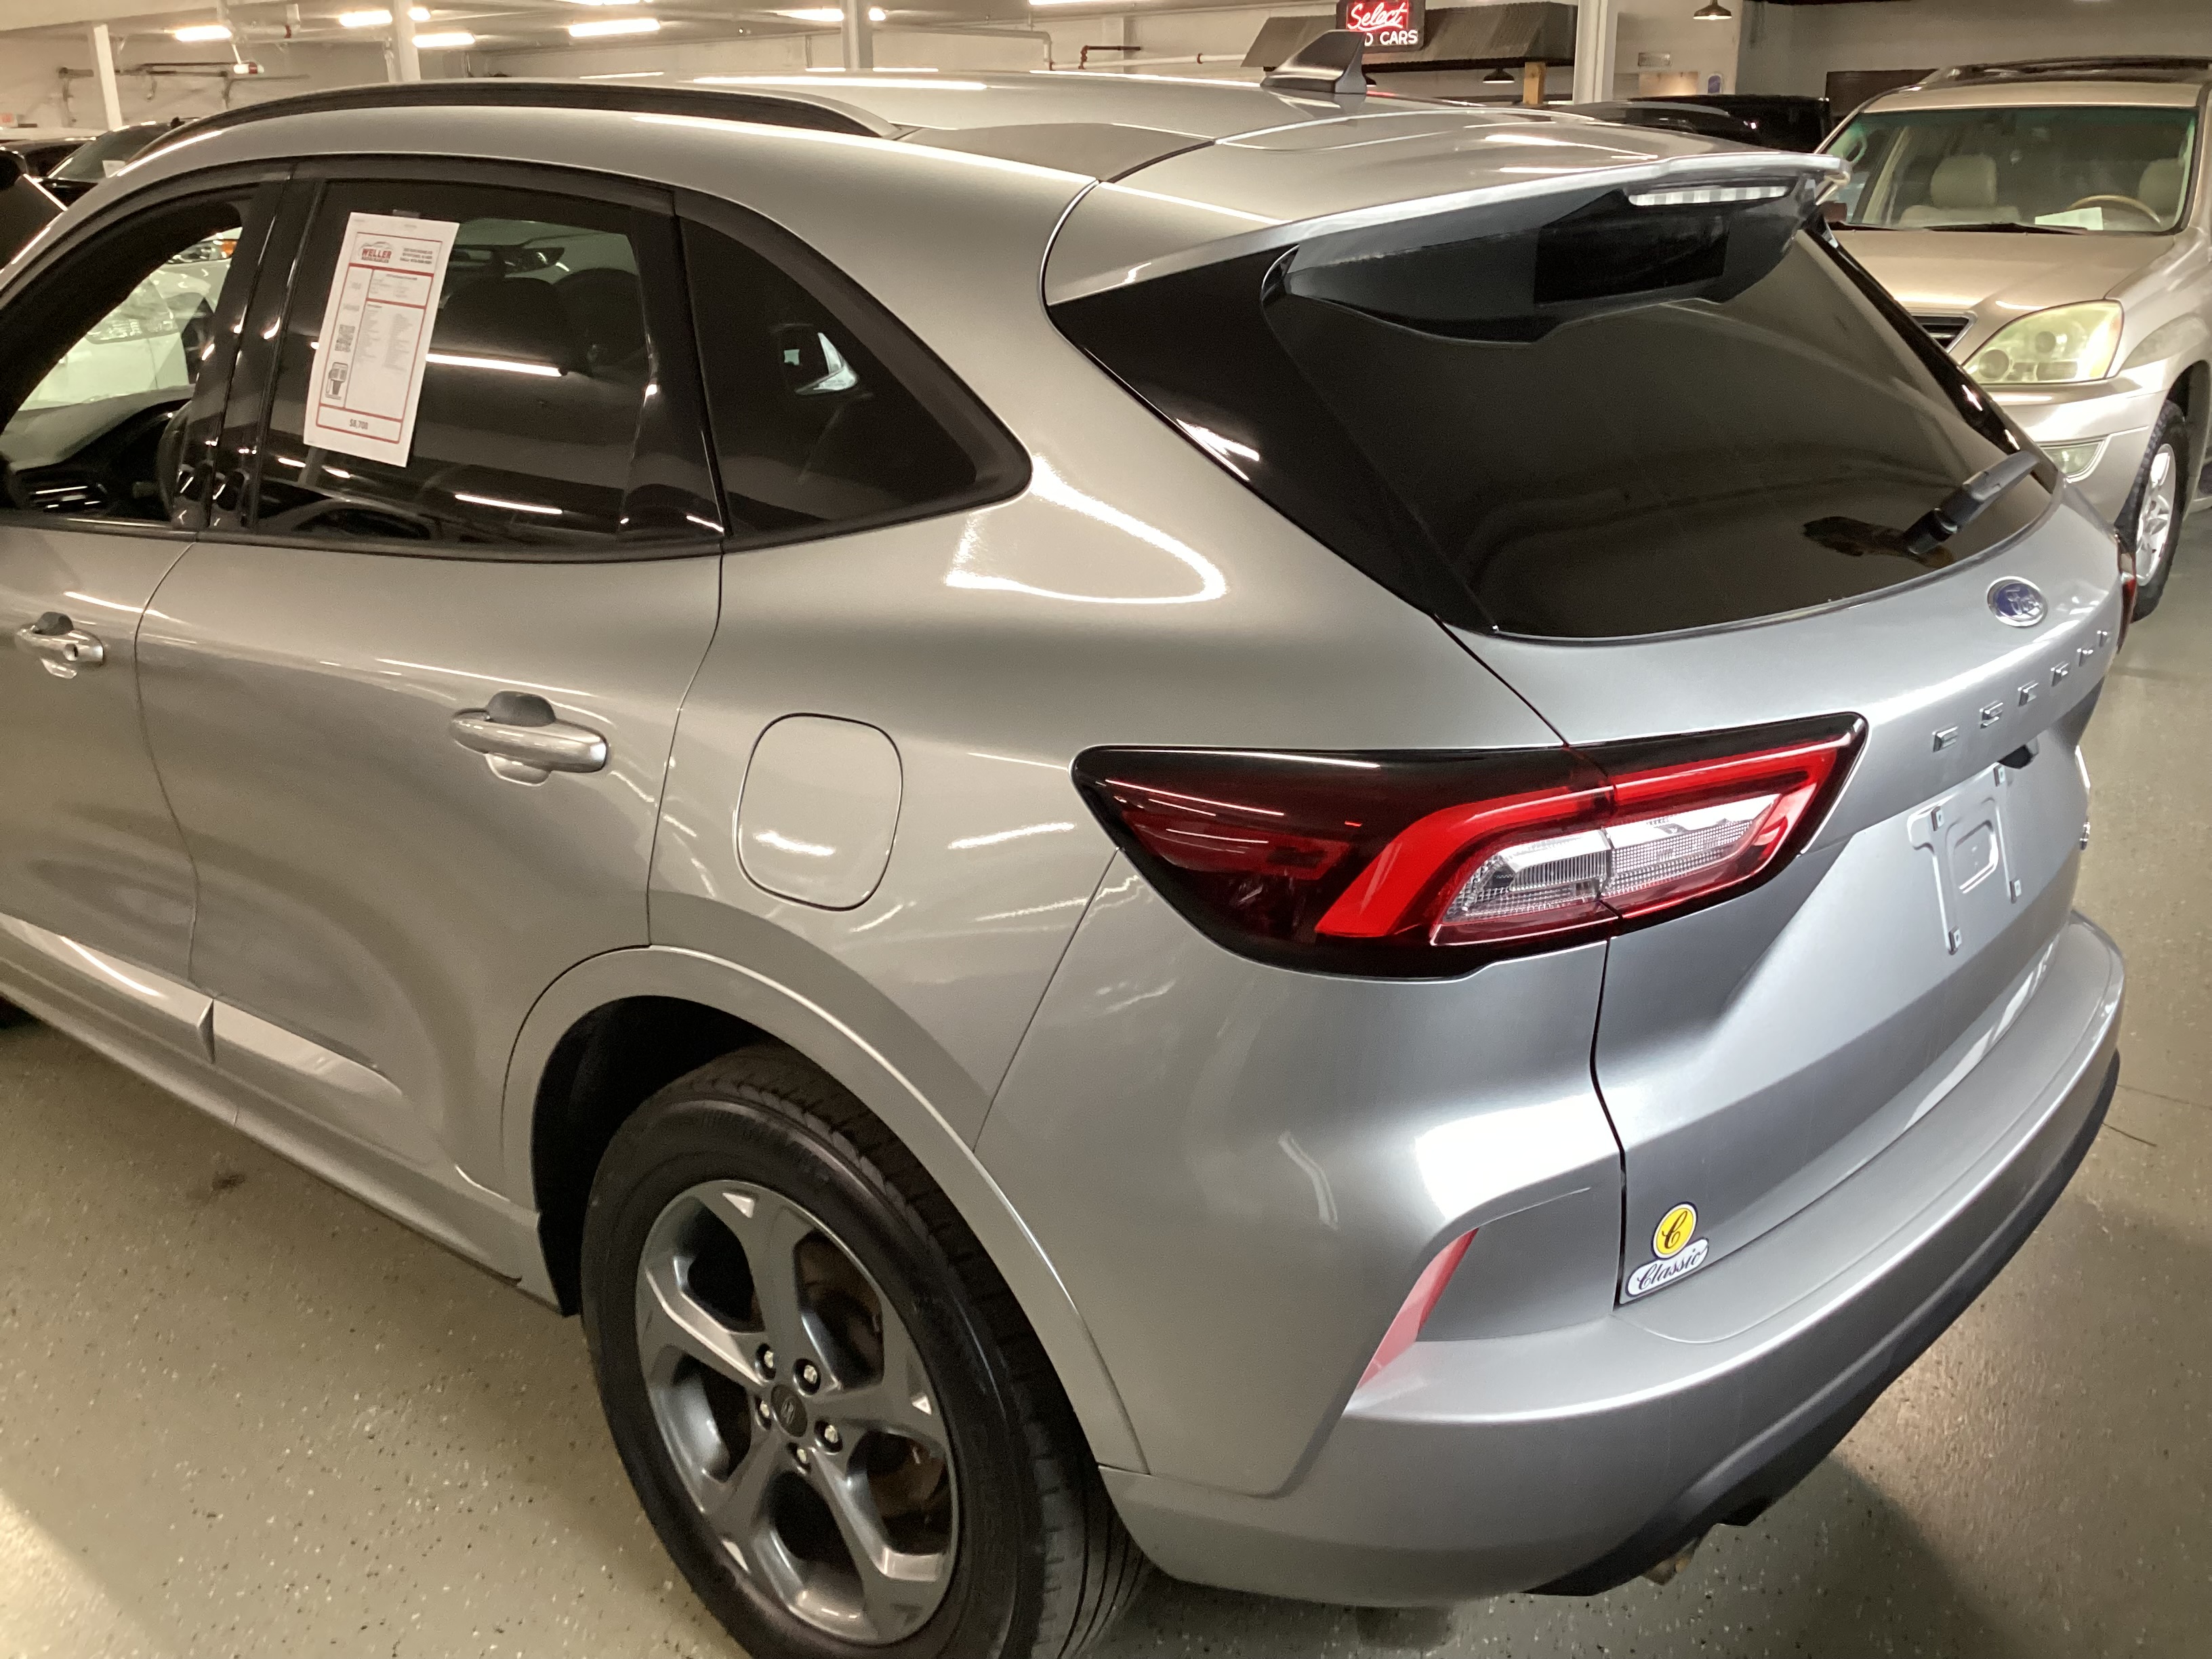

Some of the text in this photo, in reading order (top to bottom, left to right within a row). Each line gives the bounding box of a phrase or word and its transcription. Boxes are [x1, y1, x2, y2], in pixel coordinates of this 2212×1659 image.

[1347, 2, 1408, 30] Select
[1380, 30, 1418, 45] CARS
[362, 248, 392, 259] WELLER
[1637, 1248, 1702, 1290] Classic
